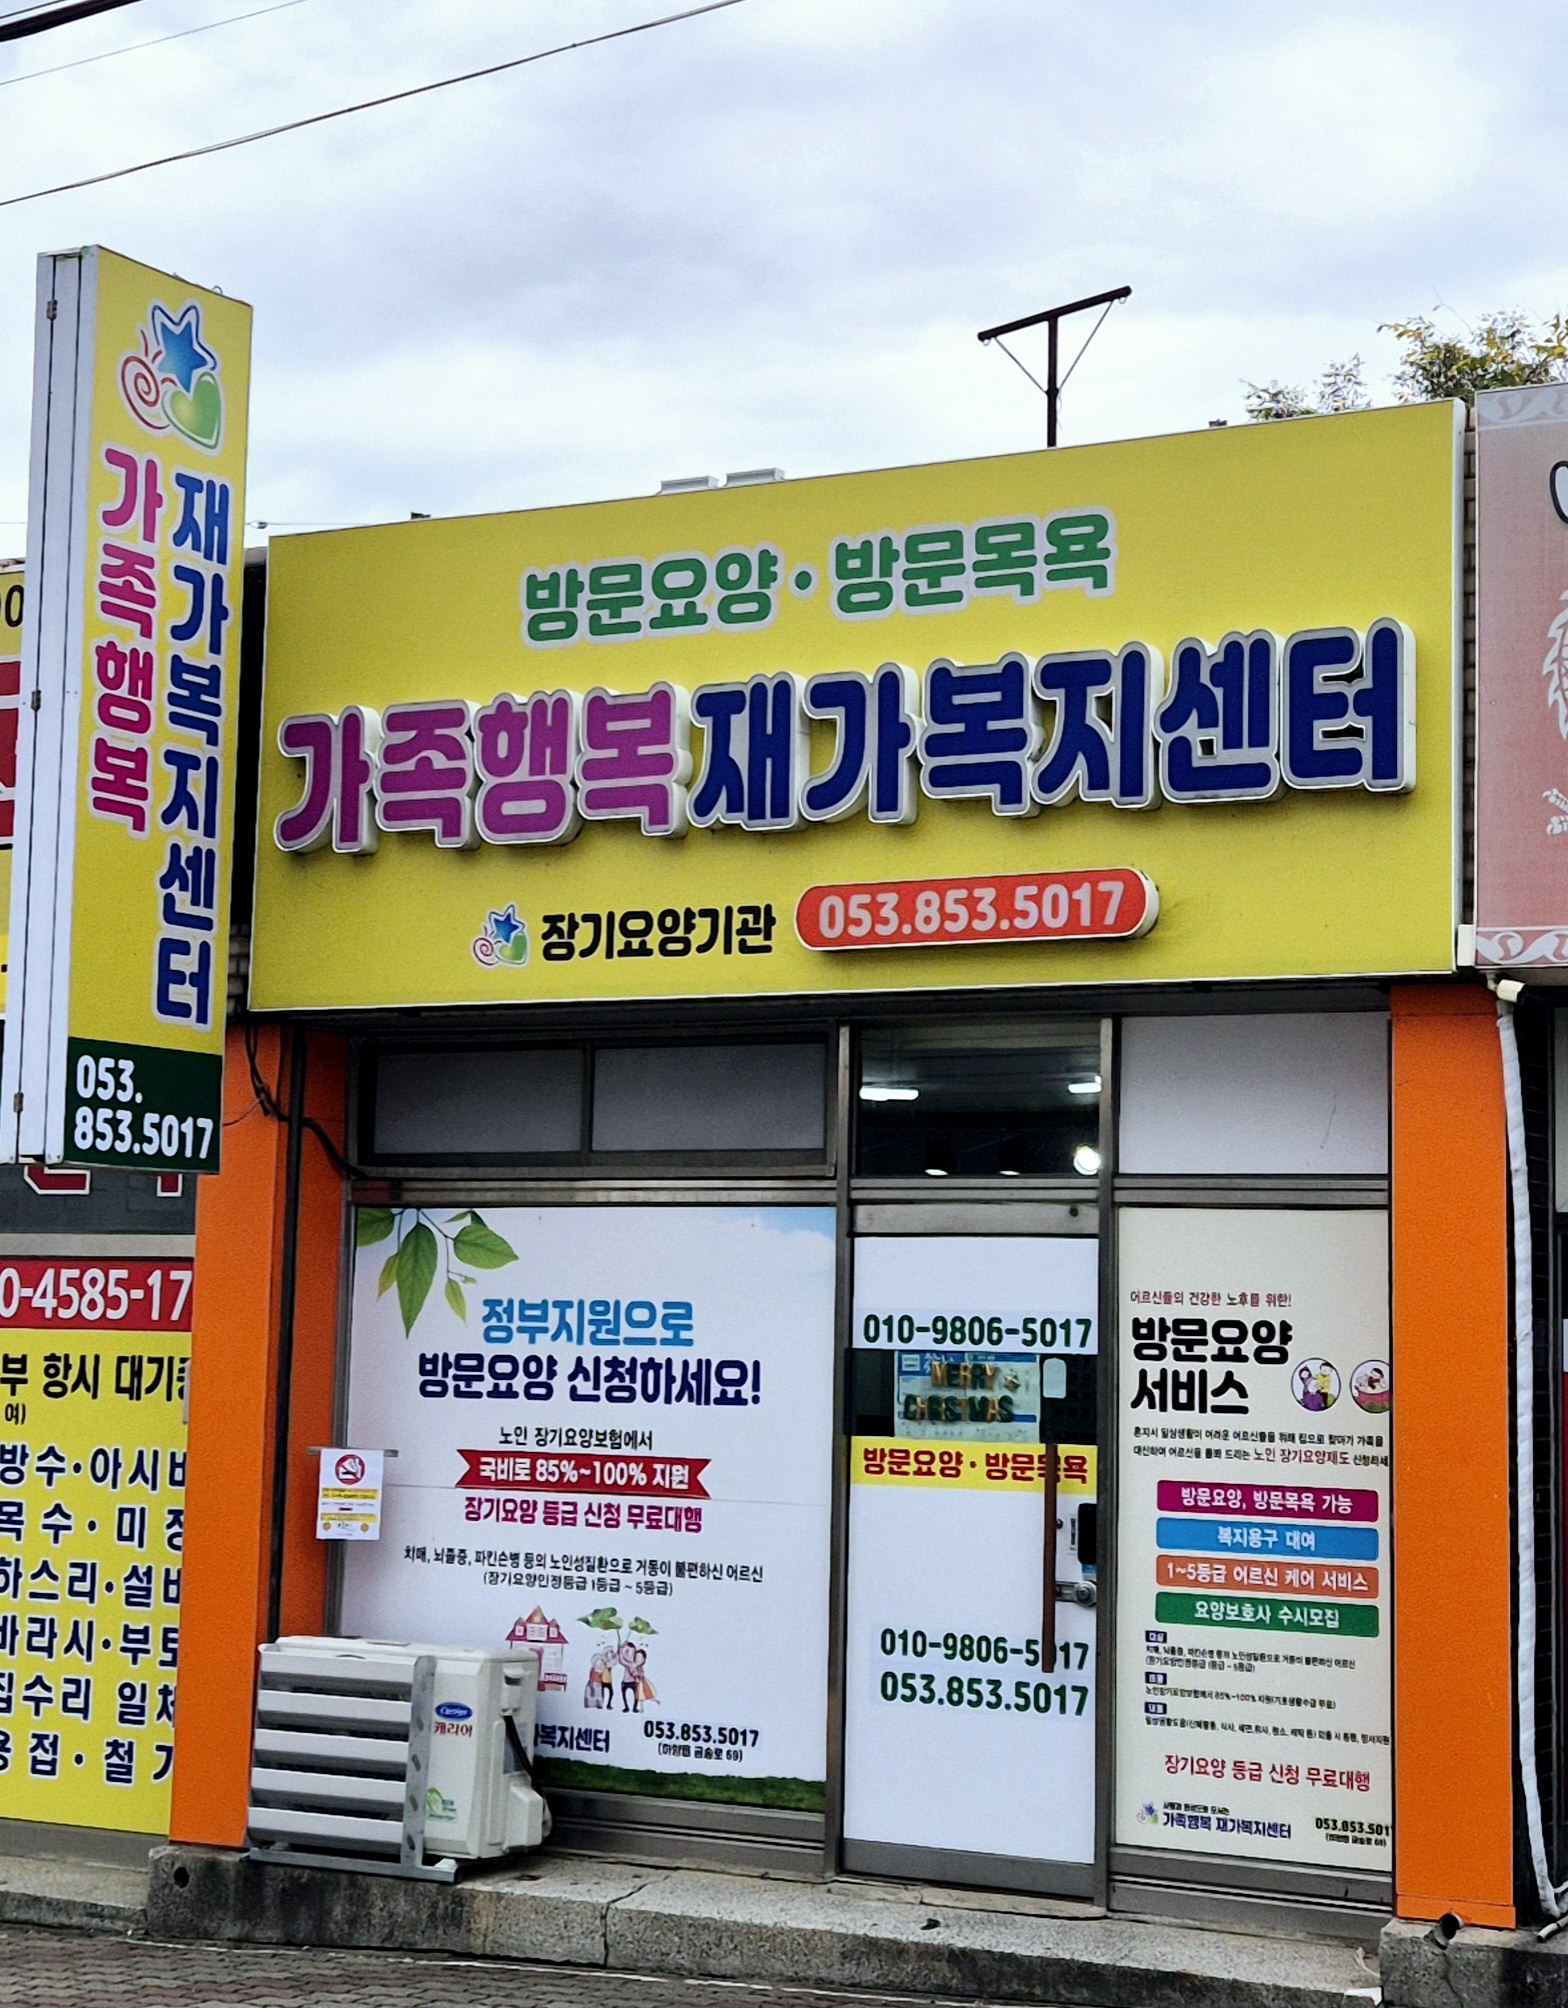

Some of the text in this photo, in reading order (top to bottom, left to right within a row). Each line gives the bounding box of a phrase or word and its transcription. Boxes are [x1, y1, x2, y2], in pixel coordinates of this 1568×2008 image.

[91, 448, 163, 833] 가족행복
[156, 472, 229, 1025] 재가복지센터
[818, 882, 1125, 940] 053.853.5017
[541, 903, 776, 962] 장기요양기관
[76, 1055, 143, 1104] 053.
[74, 1106, 214, 1160] 853.5017
[482, 1298, 694, 1347] 정부지원으로
[864, 1314, 1092, 1348] 010-9806-5017
[1132, 1316, 1292, 1365] 방문요양
[43, 1353, 100, 1399] 항시
[418, 1352, 761, 1406] 방문요양 신청하세요!
[1130, 1367, 1249, 1415] 서비스
[499, 1426, 653, 1450] 노인 장기요양보험에서
[1253, 1448, 1276, 1462] 노인
[1280, 1448, 1351, 1466] 장기요양제도
[479, 1457, 689, 1490] 국비로 85%~100% 지원
[465, 1496, 702, 1533] 장기요양 등급 신청 무료대행
[1180, 1487, 1354, 1514] 방문요양, 방문목욕 가능
[1217, 1526, 1316, 1551] 복지용구 대여
[475, 1550, 520, 1568] 파킨슨병
[549, 1553, 632, 1574] 노인성질환으로
[636, 1558, 671, 1577] 거동이
[726, 1564, 763, 1583] 어르신
[1167, 1562, 1369, 1592] 1~5등급 어르신 케어 서비스
[1194, 1600, 1340, 1629] 요양보호사 수시모집
[881, 1628, 1089, 1670] 010-9806-517
[880, 1671, 1089, 1716] 053.853.5017
[434, 1722, 473, 1737] 캐리어
[534, 1720, 759, 1753] 복지센터 053.853.5017
[1164, 1754, 1370, 1792] 장기요양 등급 신청 무료대행
[1315, 1818, 1390, 1837] 053.853.501
